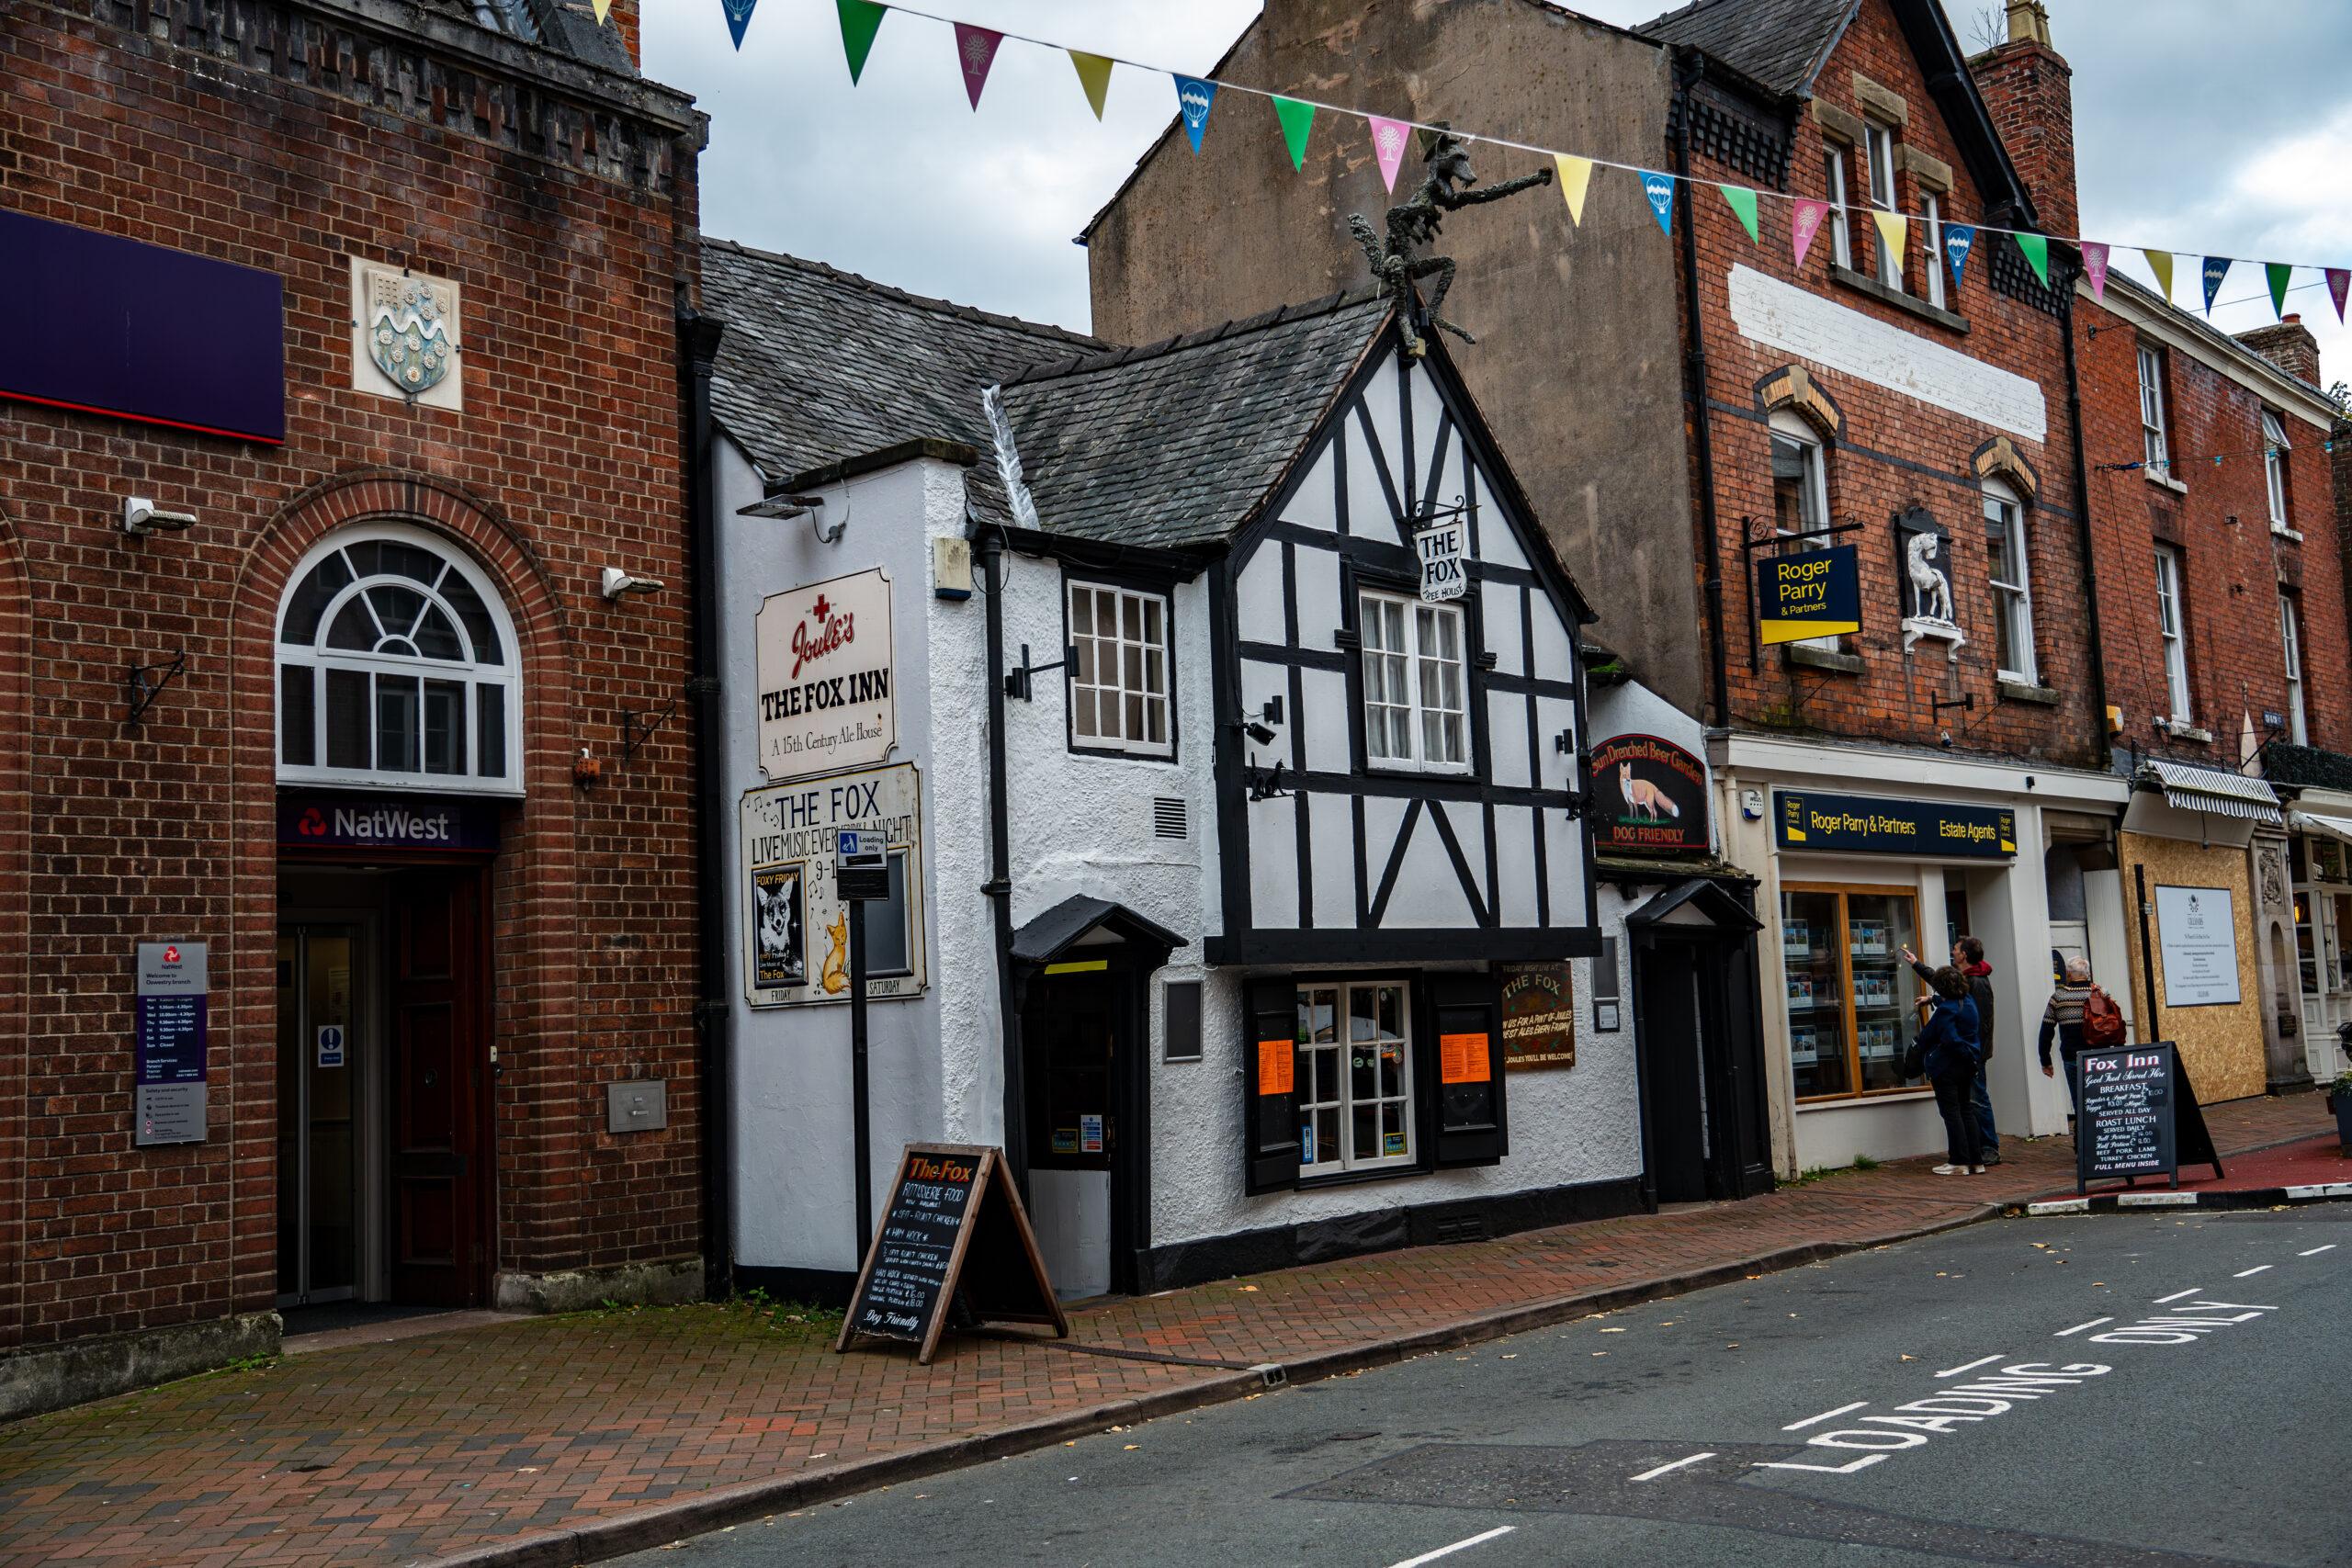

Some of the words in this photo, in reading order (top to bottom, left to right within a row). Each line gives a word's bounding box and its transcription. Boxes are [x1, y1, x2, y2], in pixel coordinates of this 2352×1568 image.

[1420, 530, 1458, 558] THE
[1426, 558, 1461, 584] FOX
[1778, 559, 1832, 581] Roger
[1442, 582, 1463, 598] HOUSE
[1780, 581, 1826, 602] Parry
[1781, 607, 1788, 615] &
[1790, 603, 1826, 615] Partners
[762, 686, 801, 722] THE
[804, 676, 845, 713] FOX
[849, 668, 888, 704] INN
[772, 739, 780, 756] A
[783, 735, 803, 753] 15th
[806, 731, 838, 755] Century
[839, 726, 854, 744] Ale
[856, 722, 882, 740] House
[1591, 754, 1609, 777] Sun
[1608, 740, 1648, 764] Drenched
[1648, 742, 1672, 763] Beer
[1670, 751, 1702, 785] Garden
[775, 792, 820, 830] THE
[831, 781, 881, 822] FOX
[1787, 801, 1801, 810] Roger
[1788, 810, 1799, 819] Parry
[334, 808, 448, 840] NatWest
[1811, 811, 1841, 834] Roger
[1843, 813, 1869, 836] Parry
[1870, 816, 1878, 832] &
[1878, 816, 1916, 835] Partners
[1939, 819, 1966, 838] Estate
[1968, 822, 1996, 843] Agents
[859, 836, 884, 844] Loading
[1613, 826, 1635, 840] DOG
[1638, 828, 1685, 843] FRIENDLY
[752, 835, 781, 865] LIVE
[781, 830, 810, 860] MUSIC
[812, 826, 838, 854] EVER
[757, 874, 774, 886] FOXY
[775, 872, 799, 884] FRIDAY
[816, 859, 836, 881] 9-1
[759, 970, 772, 979] The
[773, 970, 785, 979] Fox
[772, 990, 790, 1001] FRIDAY
[869, 980, 900, 994] SATURDAY
[1503, 975, 1530, 999] THE
[1535, 974, 1560, 995] FOX
[1508, 1019, 1516, 1029] US
[1517, 1016, 1529, 1027] FOR
[1529, 1015, 1534, 1024] A
[1534, 1013, 1548, 1023] PINT
[1548, 1012, 1555, 1021] OF
[1518, 1027, 1534, 1037] ALES
[1534, 1025, 1551, 1035] EVERY
[1507, 1055, 1525, 1064] JOULES
[2086, 1058, 2118, 1073] Fox
[2126, 1054, 2159, 1068] Inn
[2085, 1075, 2104, 1088] Good
[2104, 1073, 2120, 1082] Food
[2122, 1070, 2147, 1081] Served
[2148, 1068, 2165, 1077] Here
[2100, 1082, 2147, 1093] BREAKFAST
[2097, 1118, 2122, 1128] ROAST
[2125, 1115, 2156, 1124] LUNCH
[909, 1158, 939, 1180] The
[938, 1160, 972, 1182] Fox
[944, 1188, 964, 1201] FOOD
[933, 1213, 956, 1225] CHICKEN
[892, 1227, 904, 1238] HAM
[907, 1231, 922, 1241] HOCK
[864, 1310, 882, 1325] Dog
[884, 1312, 919, 1331] Friendly
[1753, 1362, 2112, 1473] LOADING
[2088, 1300, 2278, 1344] ONLY
